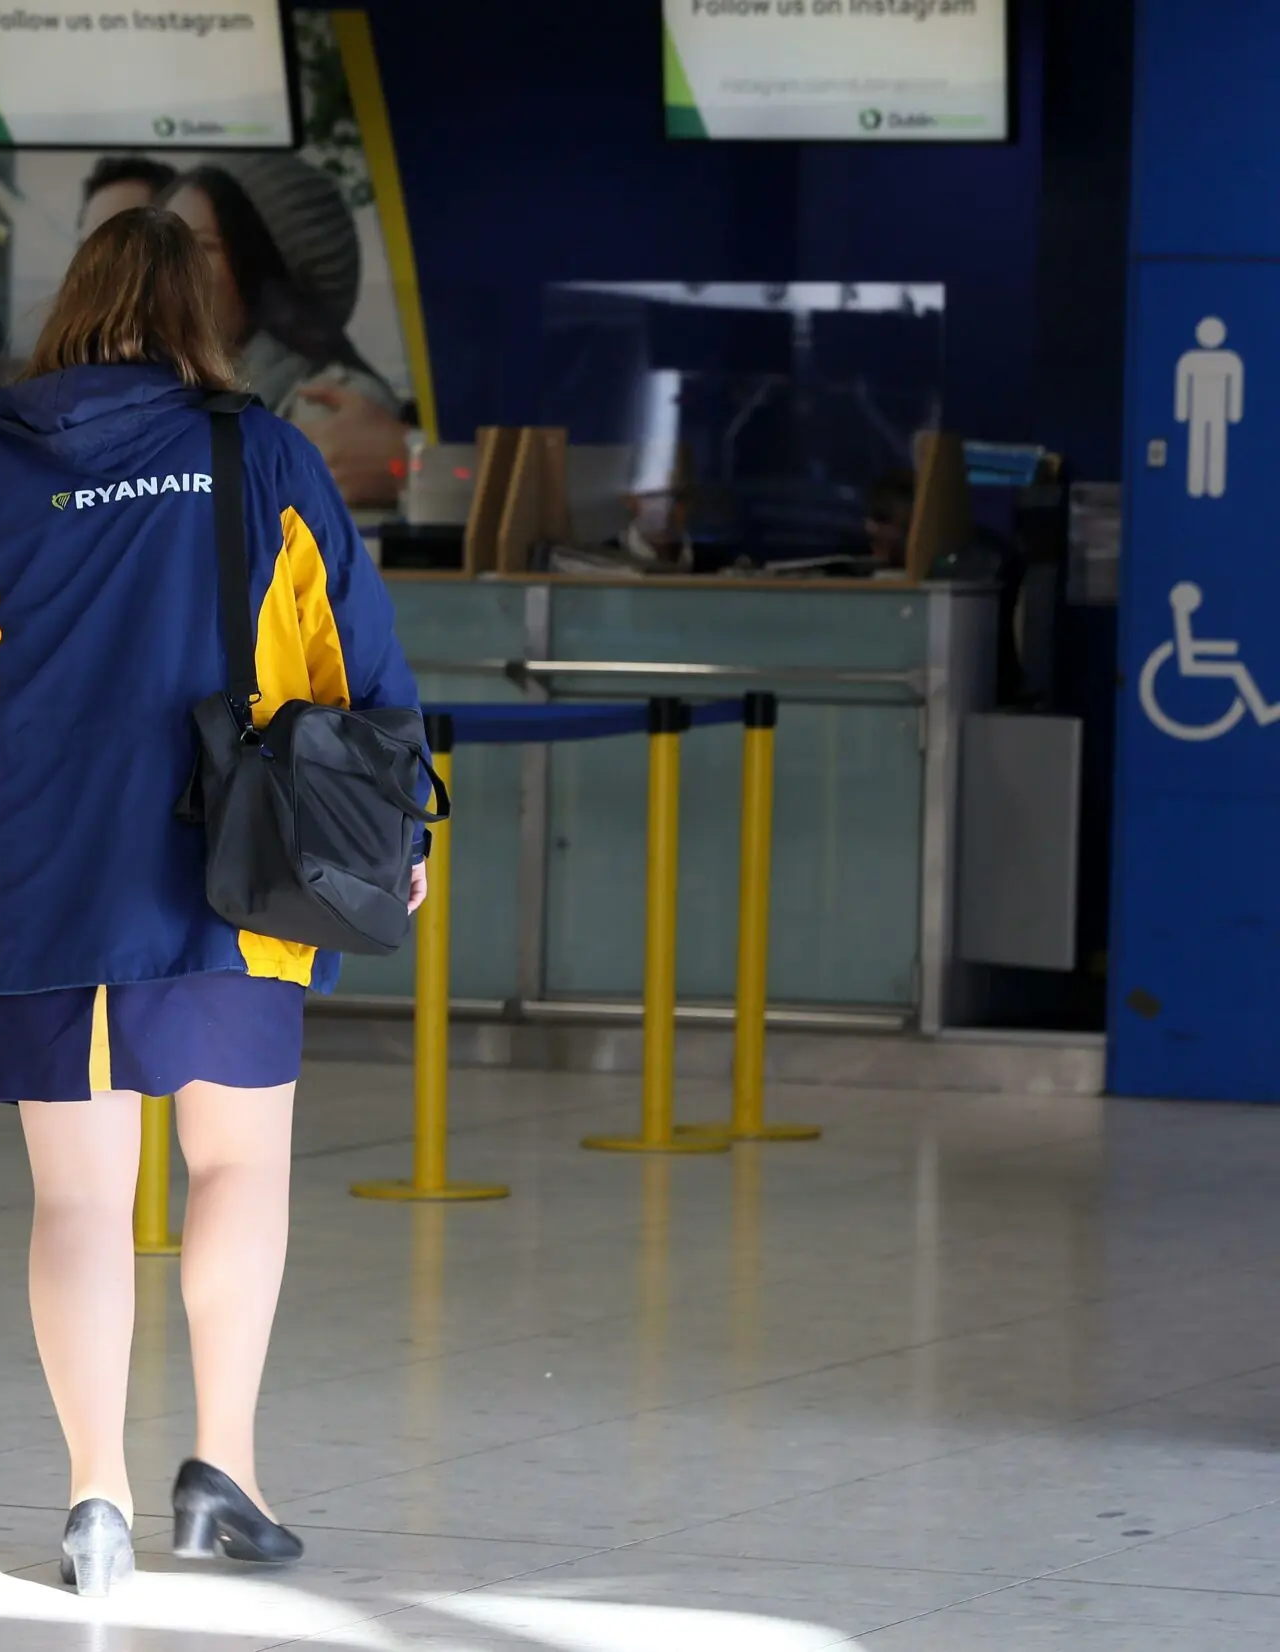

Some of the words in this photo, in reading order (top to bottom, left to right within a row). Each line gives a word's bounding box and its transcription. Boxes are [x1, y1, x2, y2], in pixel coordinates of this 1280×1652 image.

[65, 12, 93, 30] us
[98, 12, 127, 30] on
[133, 8, 254, 36] Instagram
[691, 0, 770, 16] Follow
[776, 0, 806, 16] us
[812, 0, 842, 16] on
[849, 0, 977, 22] Instagram
[75, 473, 213, 510] RYANAIR
